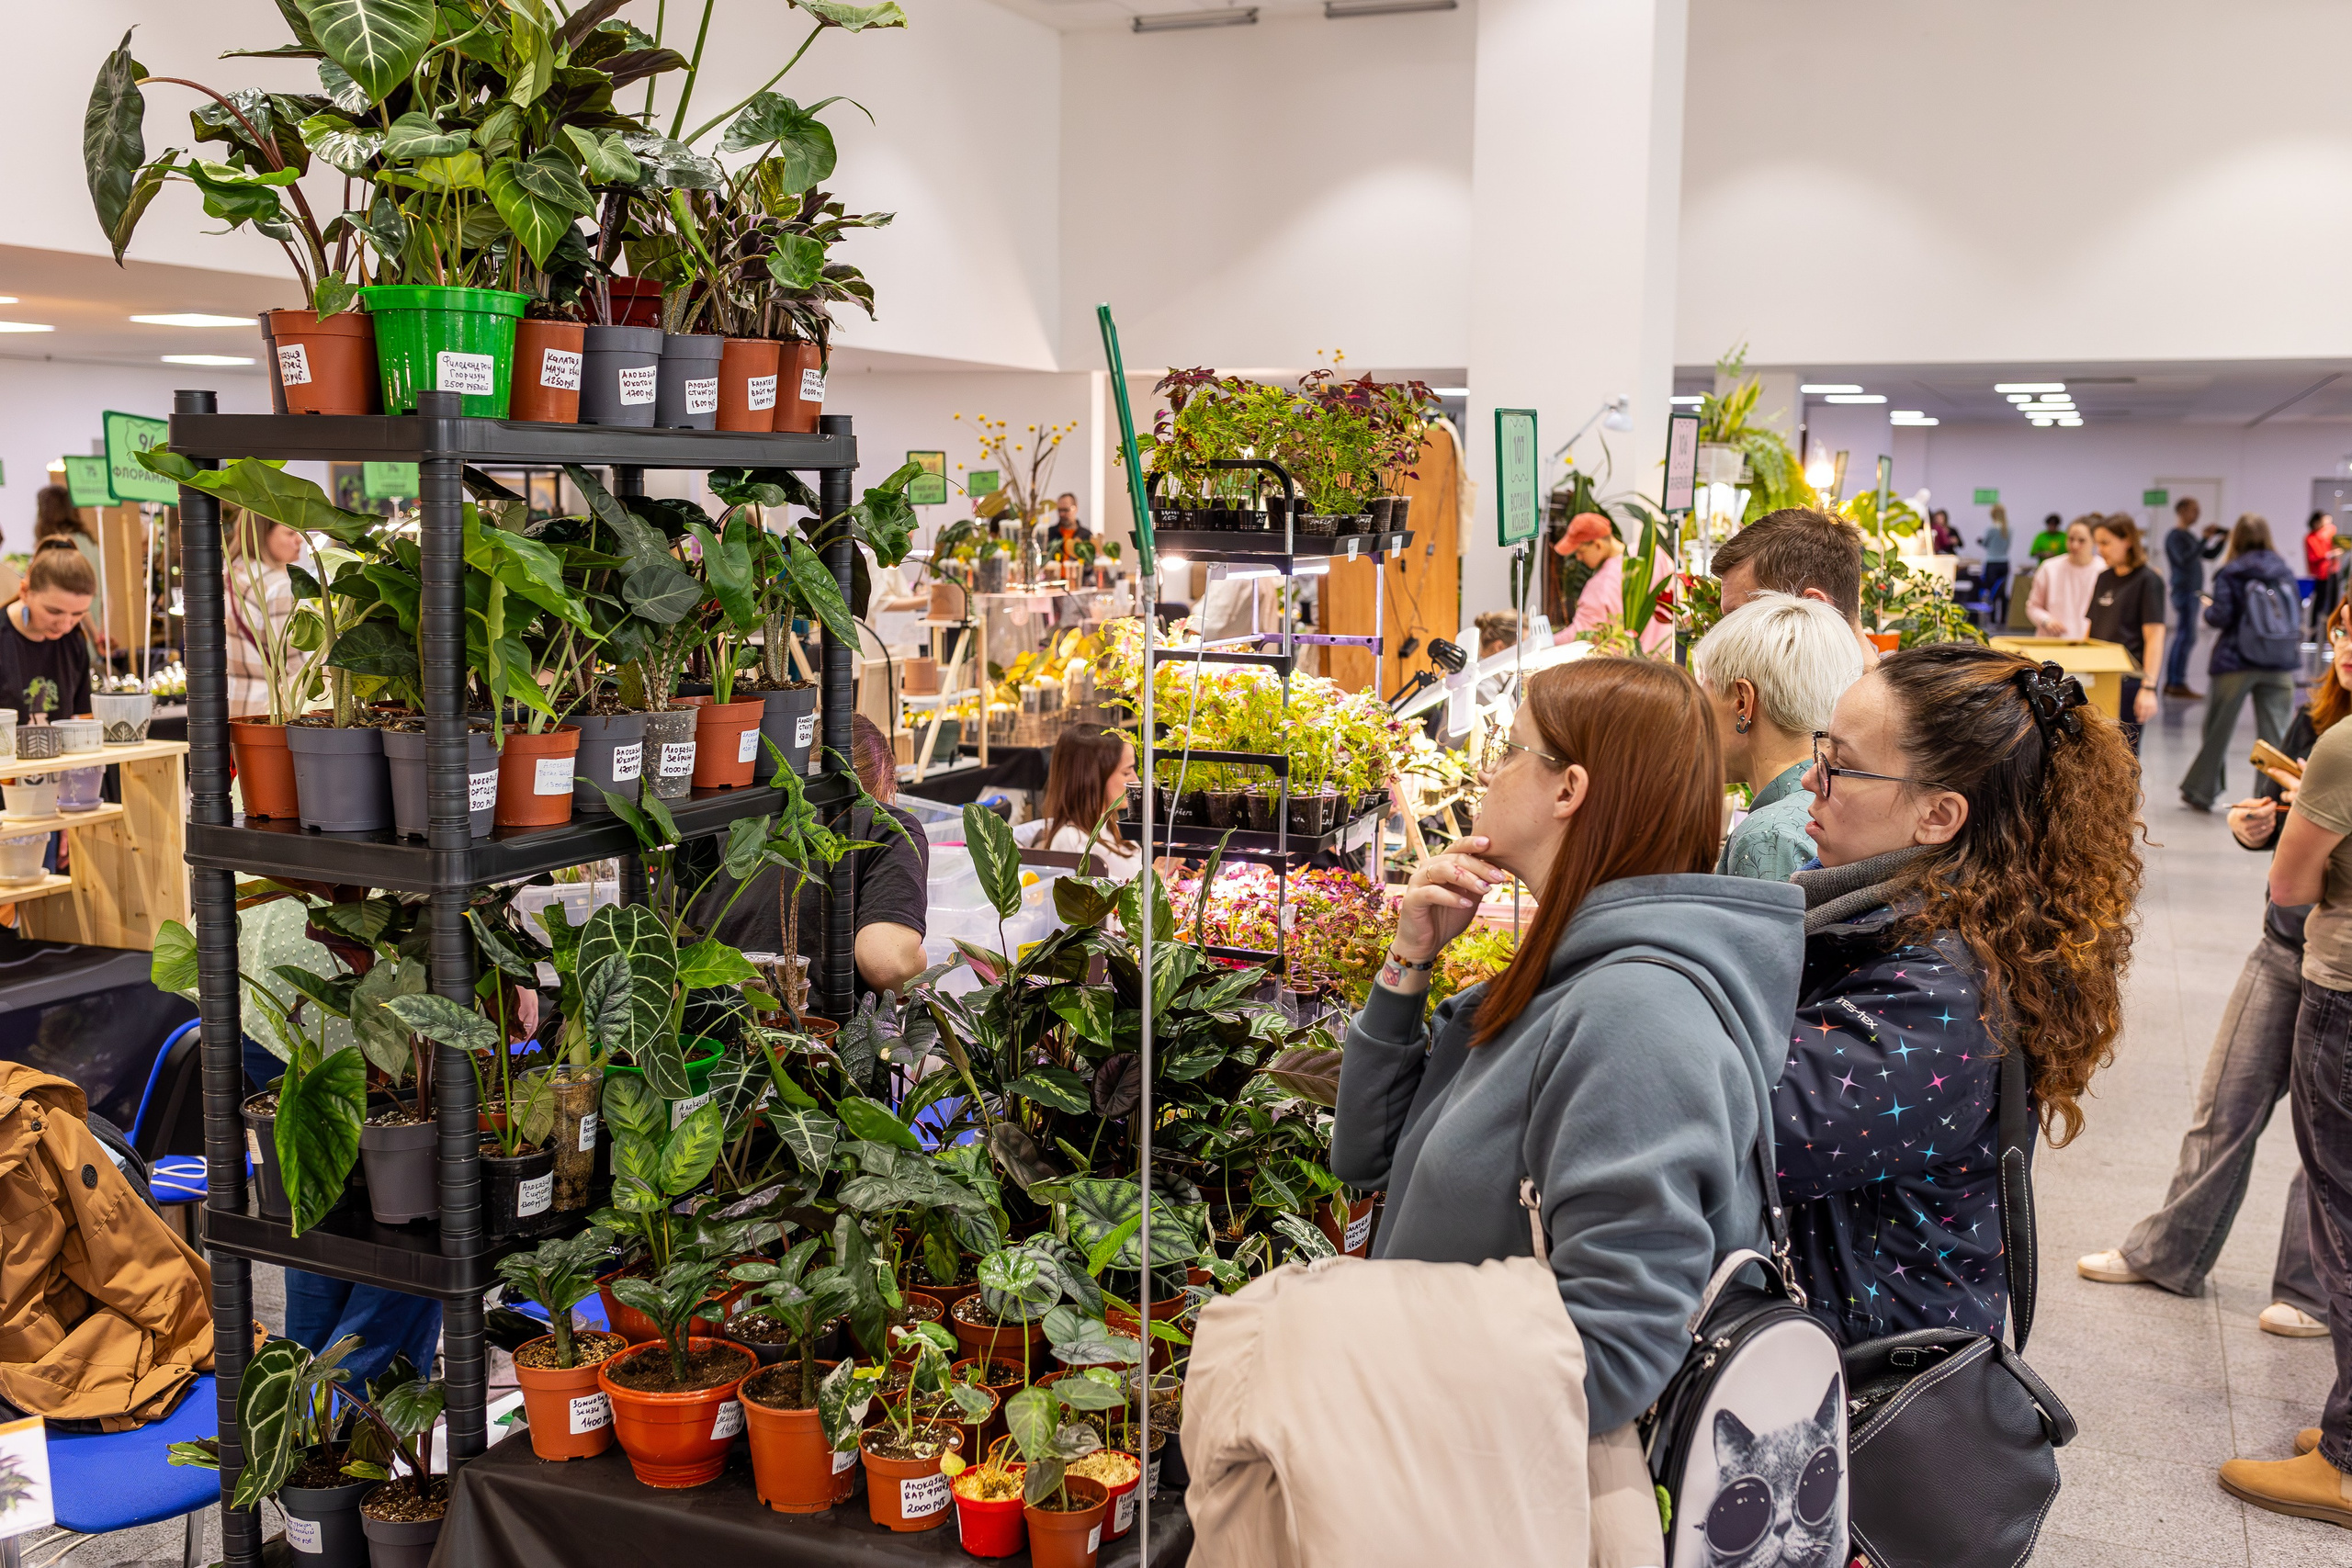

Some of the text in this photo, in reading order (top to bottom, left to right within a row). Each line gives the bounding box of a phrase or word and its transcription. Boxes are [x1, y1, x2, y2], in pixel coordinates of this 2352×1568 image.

[444, 379, 465, 389] 2500
[581, 1416, 602, 1427] 1400
[906, 1503, 932, 1514] 2000
